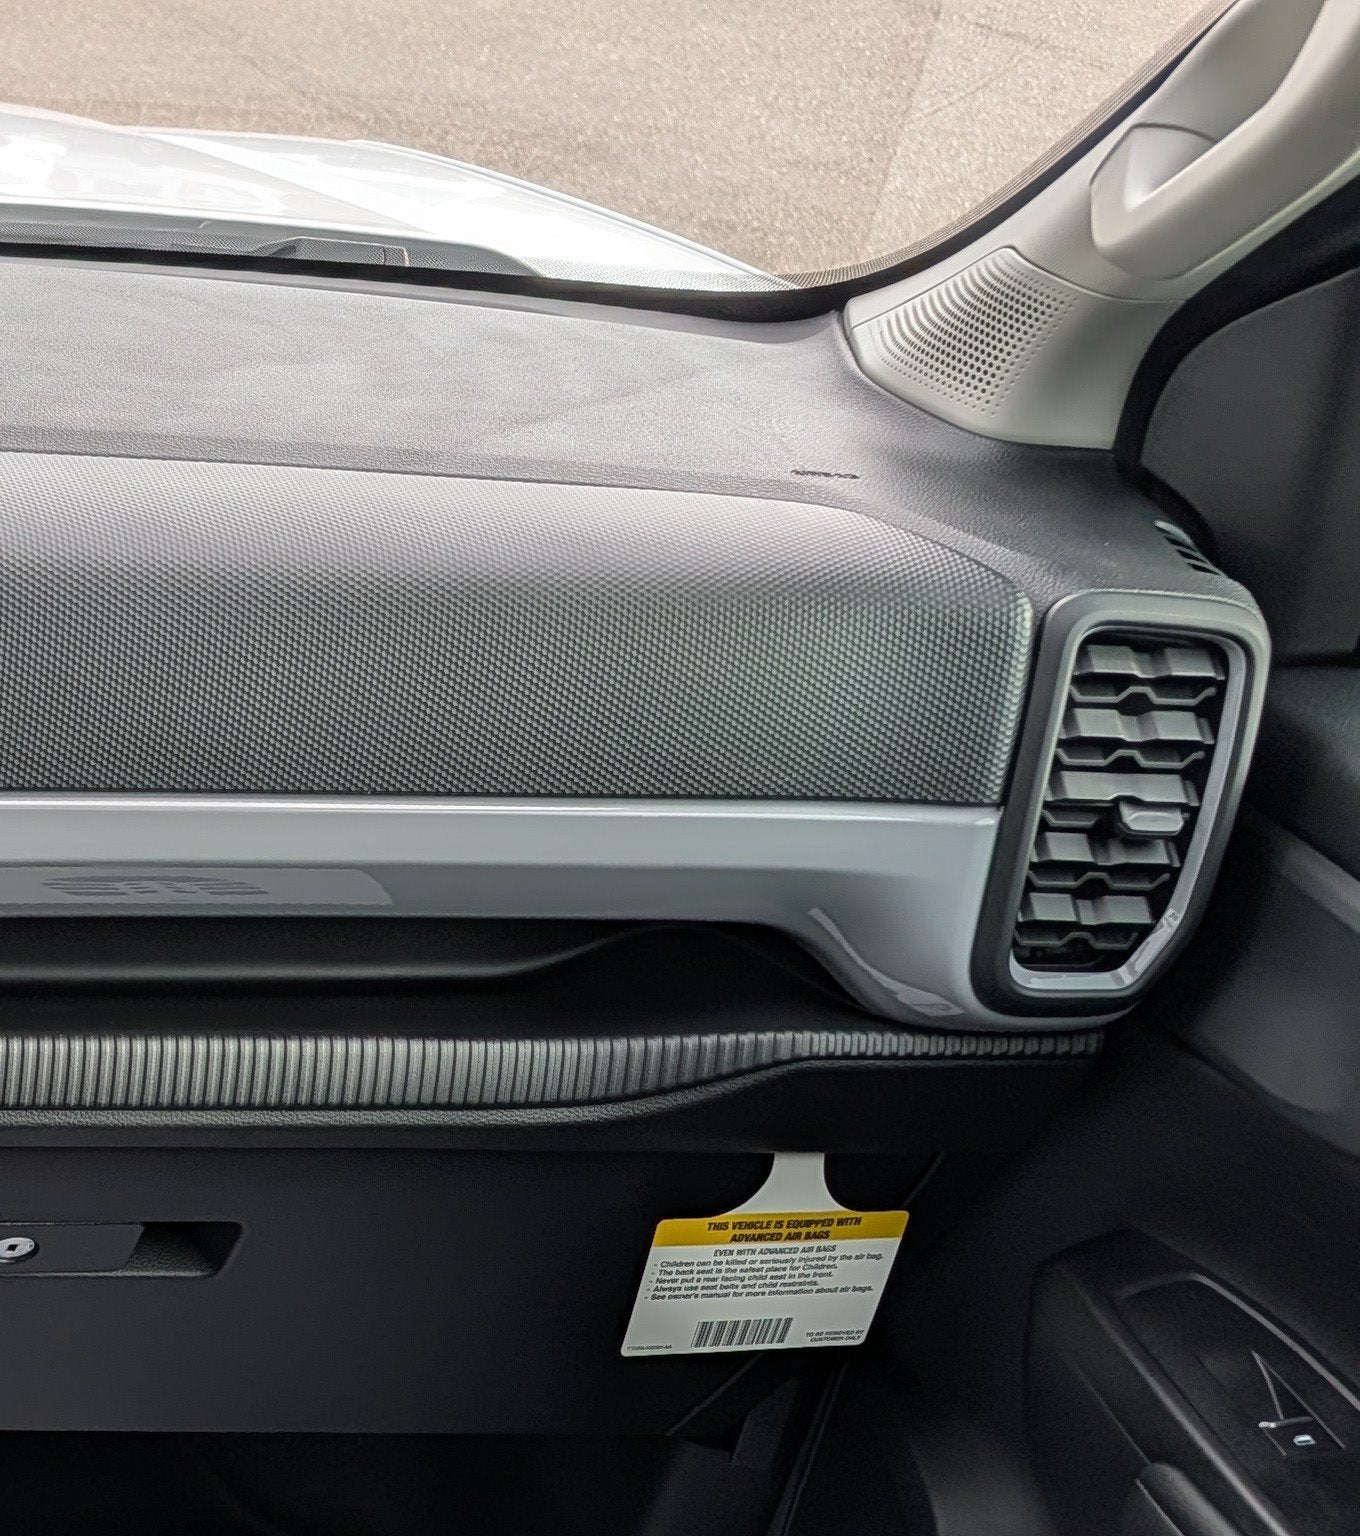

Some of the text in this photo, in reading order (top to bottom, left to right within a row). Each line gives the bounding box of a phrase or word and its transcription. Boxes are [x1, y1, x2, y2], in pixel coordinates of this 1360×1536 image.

[707, 1217, 862, 1231] THIS VEHICLE IS EQUIPPED WITH
[729, 1231, 830, 1243] ADVANCED AIR BAGS
